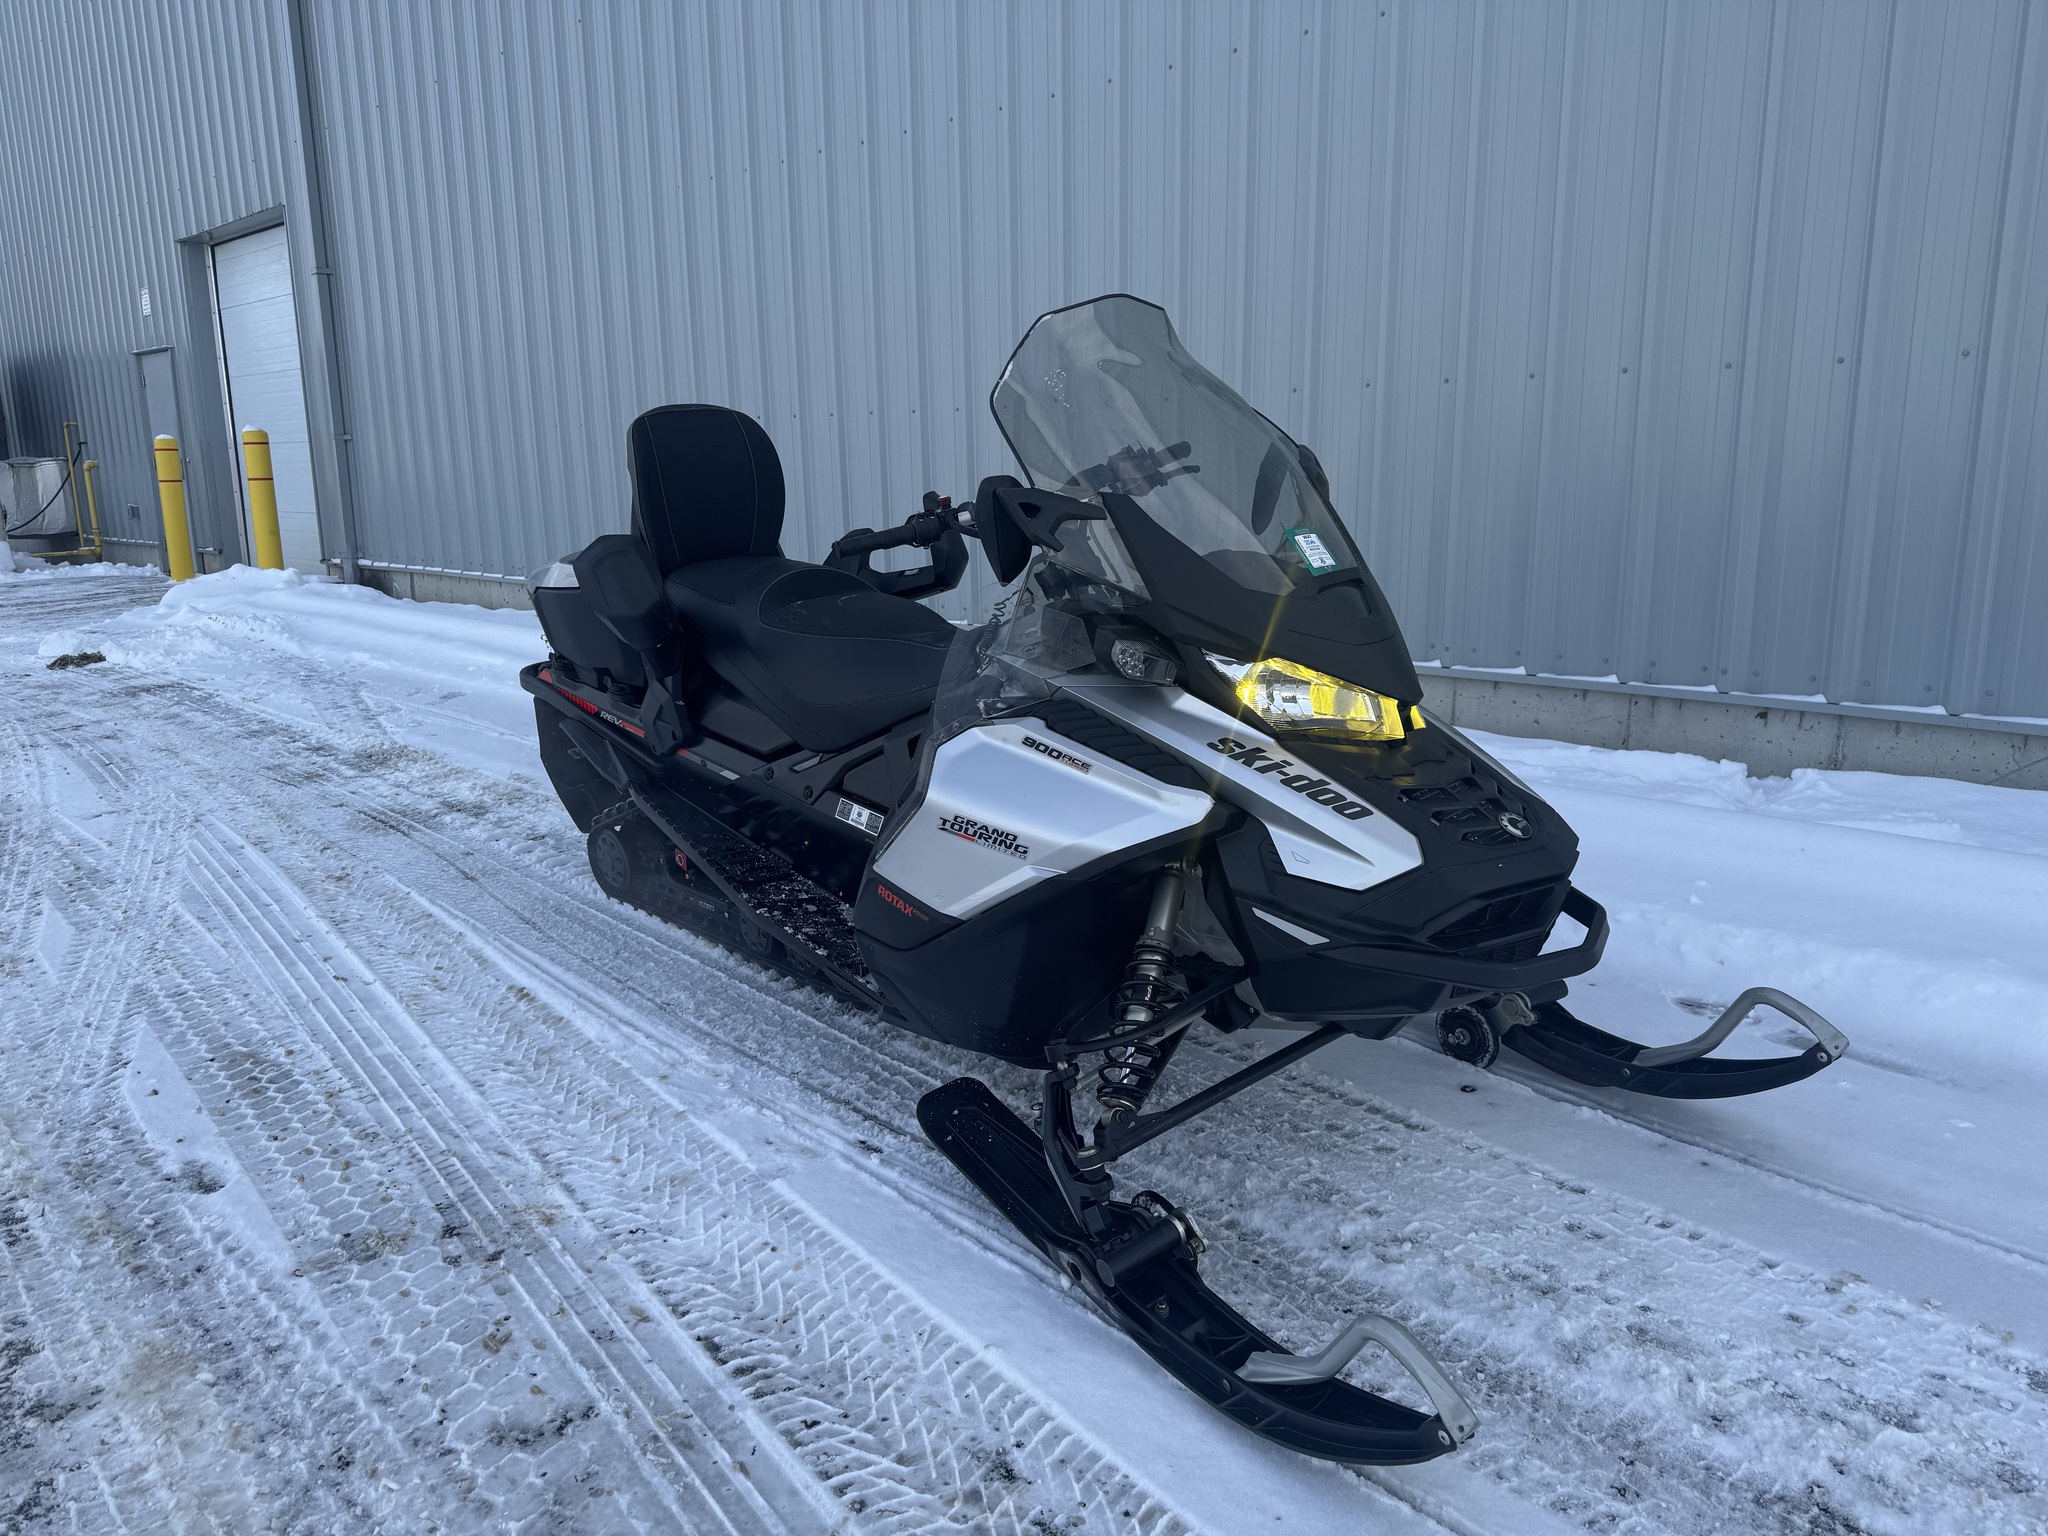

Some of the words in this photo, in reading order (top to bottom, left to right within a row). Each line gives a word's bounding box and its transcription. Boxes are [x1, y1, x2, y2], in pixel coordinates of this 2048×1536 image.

[600, 710, 623, 726] REV
[939, 817, 1029, 855] TOURING
[953, 815, 1018, 842] GRAND
[975, 839, 1027, 860] LIMITED
[878, 884, 913, 917] ROTAX
